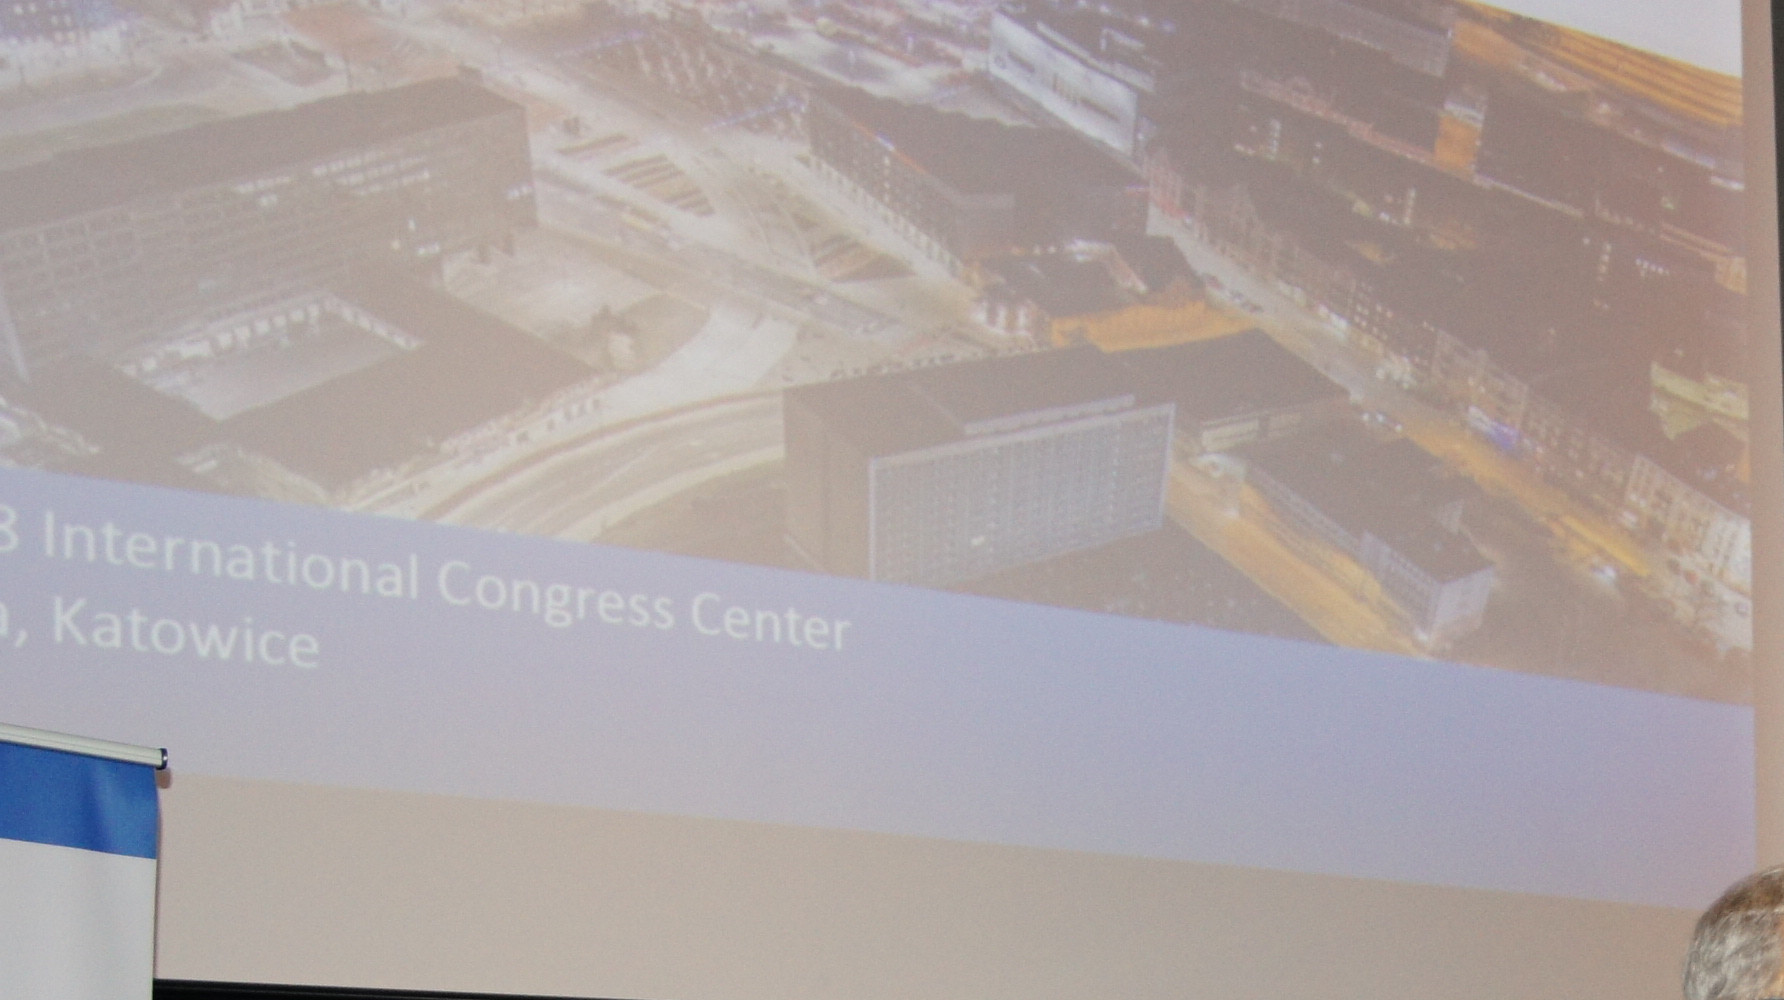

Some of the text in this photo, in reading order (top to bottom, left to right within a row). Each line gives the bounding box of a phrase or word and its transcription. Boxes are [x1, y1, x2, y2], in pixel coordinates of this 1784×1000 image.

[43, 510, 418, 599] International
[437, 560, 675, 629] Congress
[691, 592, 852, 651] Center
[52, 596, 320, 669] Katowice
